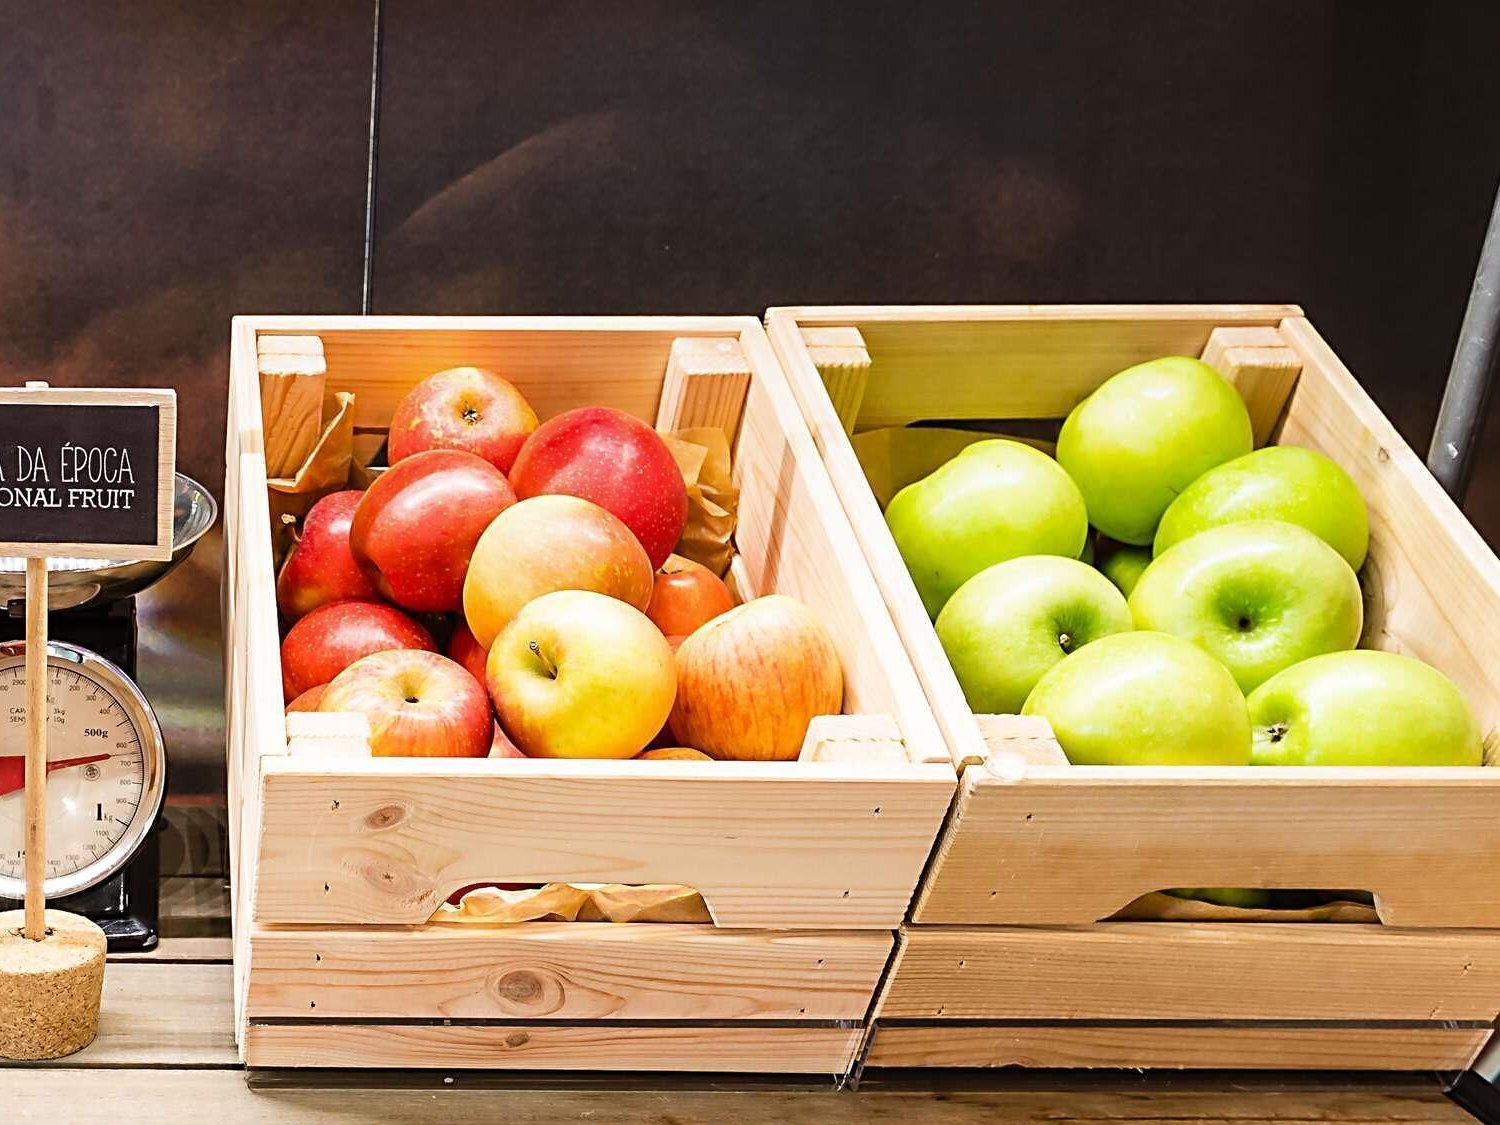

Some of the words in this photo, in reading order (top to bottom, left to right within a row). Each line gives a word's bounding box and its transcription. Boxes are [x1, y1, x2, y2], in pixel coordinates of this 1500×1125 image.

[16, 445, 50, 483] DA
[61, 441, 135, 484] ÉPOCA
[68, 488, 135, 509] FRUIT
[84, 728, 108, 738] 500g
